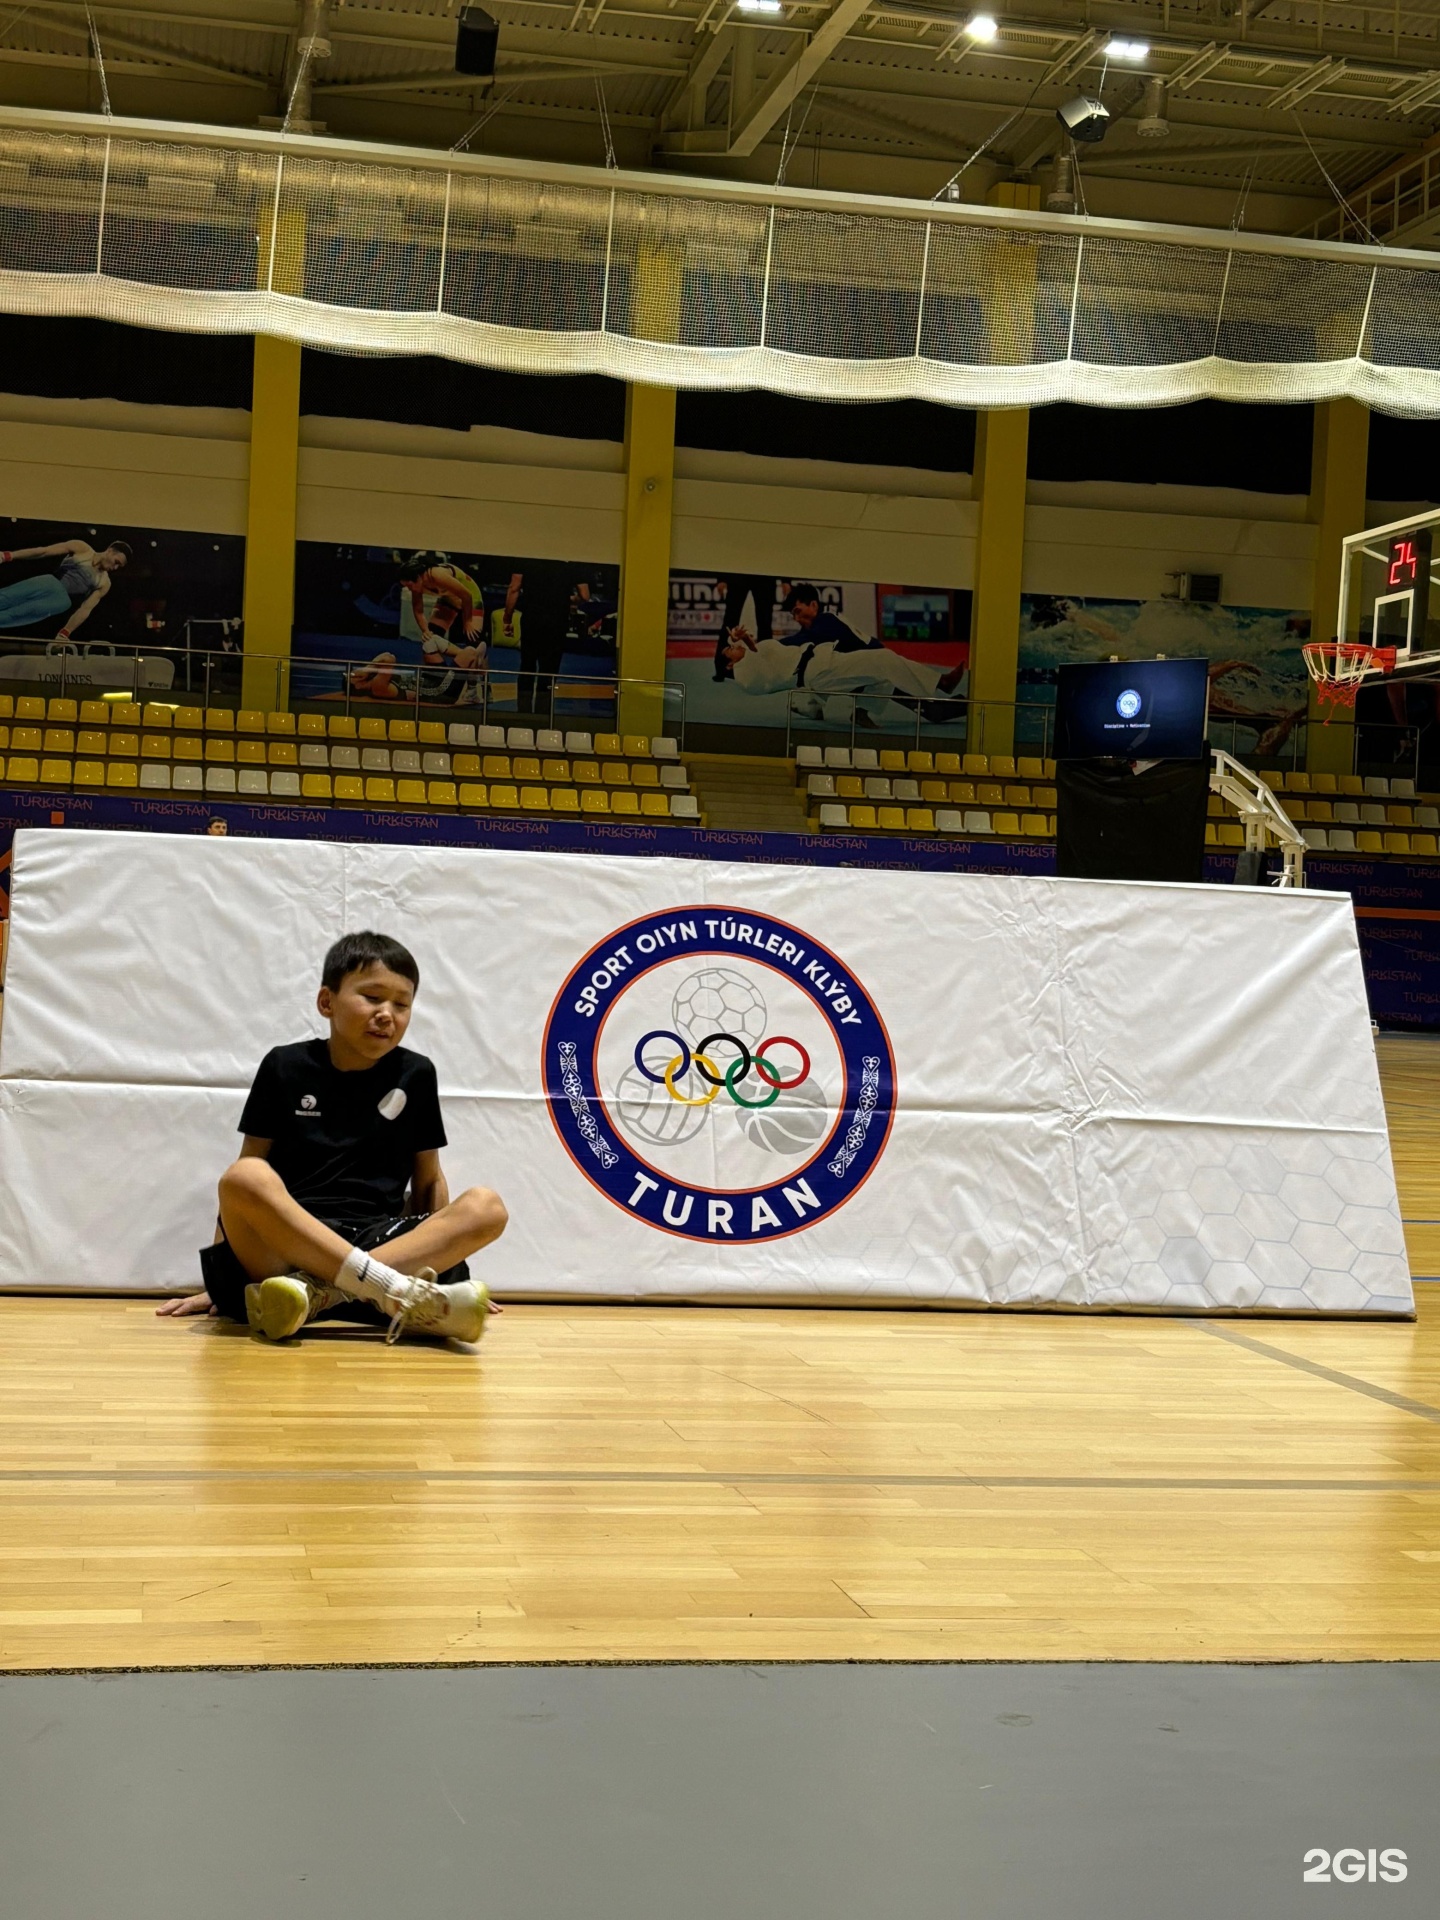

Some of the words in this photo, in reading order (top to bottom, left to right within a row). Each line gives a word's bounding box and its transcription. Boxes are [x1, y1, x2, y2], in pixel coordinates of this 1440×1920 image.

[1390, 542, 1416, 584] 24
[574, 945, 634, 1018] SPORT
[635, 920, 698, 954] OIYN
[704, 916, 805, 966] TÚRLERI
[802, 959, 862, 1026] KLÝBY
[627, 1171, 822, 1234] TURAN
